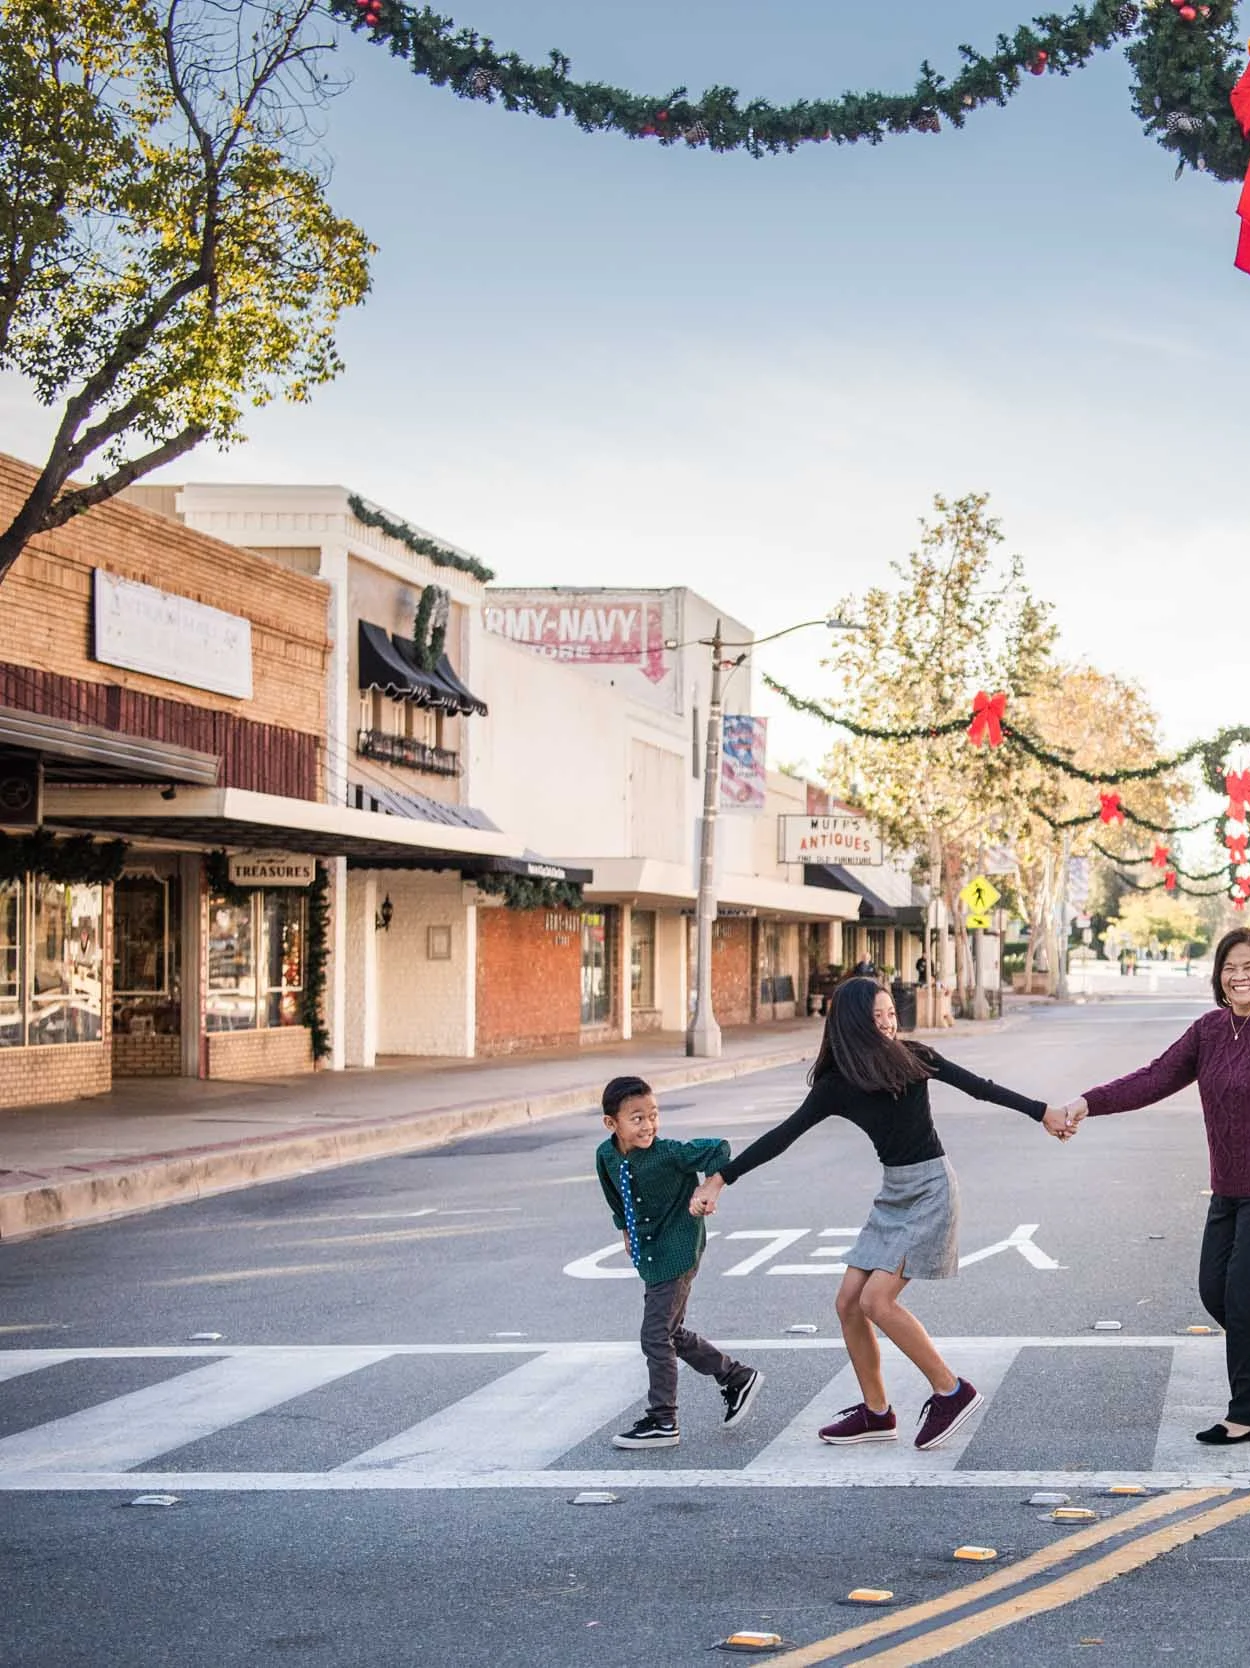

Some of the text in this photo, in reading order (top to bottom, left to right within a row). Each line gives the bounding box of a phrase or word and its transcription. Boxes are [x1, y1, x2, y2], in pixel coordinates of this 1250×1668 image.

[486, 607, 637, 642] RMY-NAVY
[528, 645, 592, 659] TORE
[801, 833, 871, 852] ANTIQUES
[235, 865, 311, 878] TREASURES
[563, 1224, 1070, 1279] YELD
